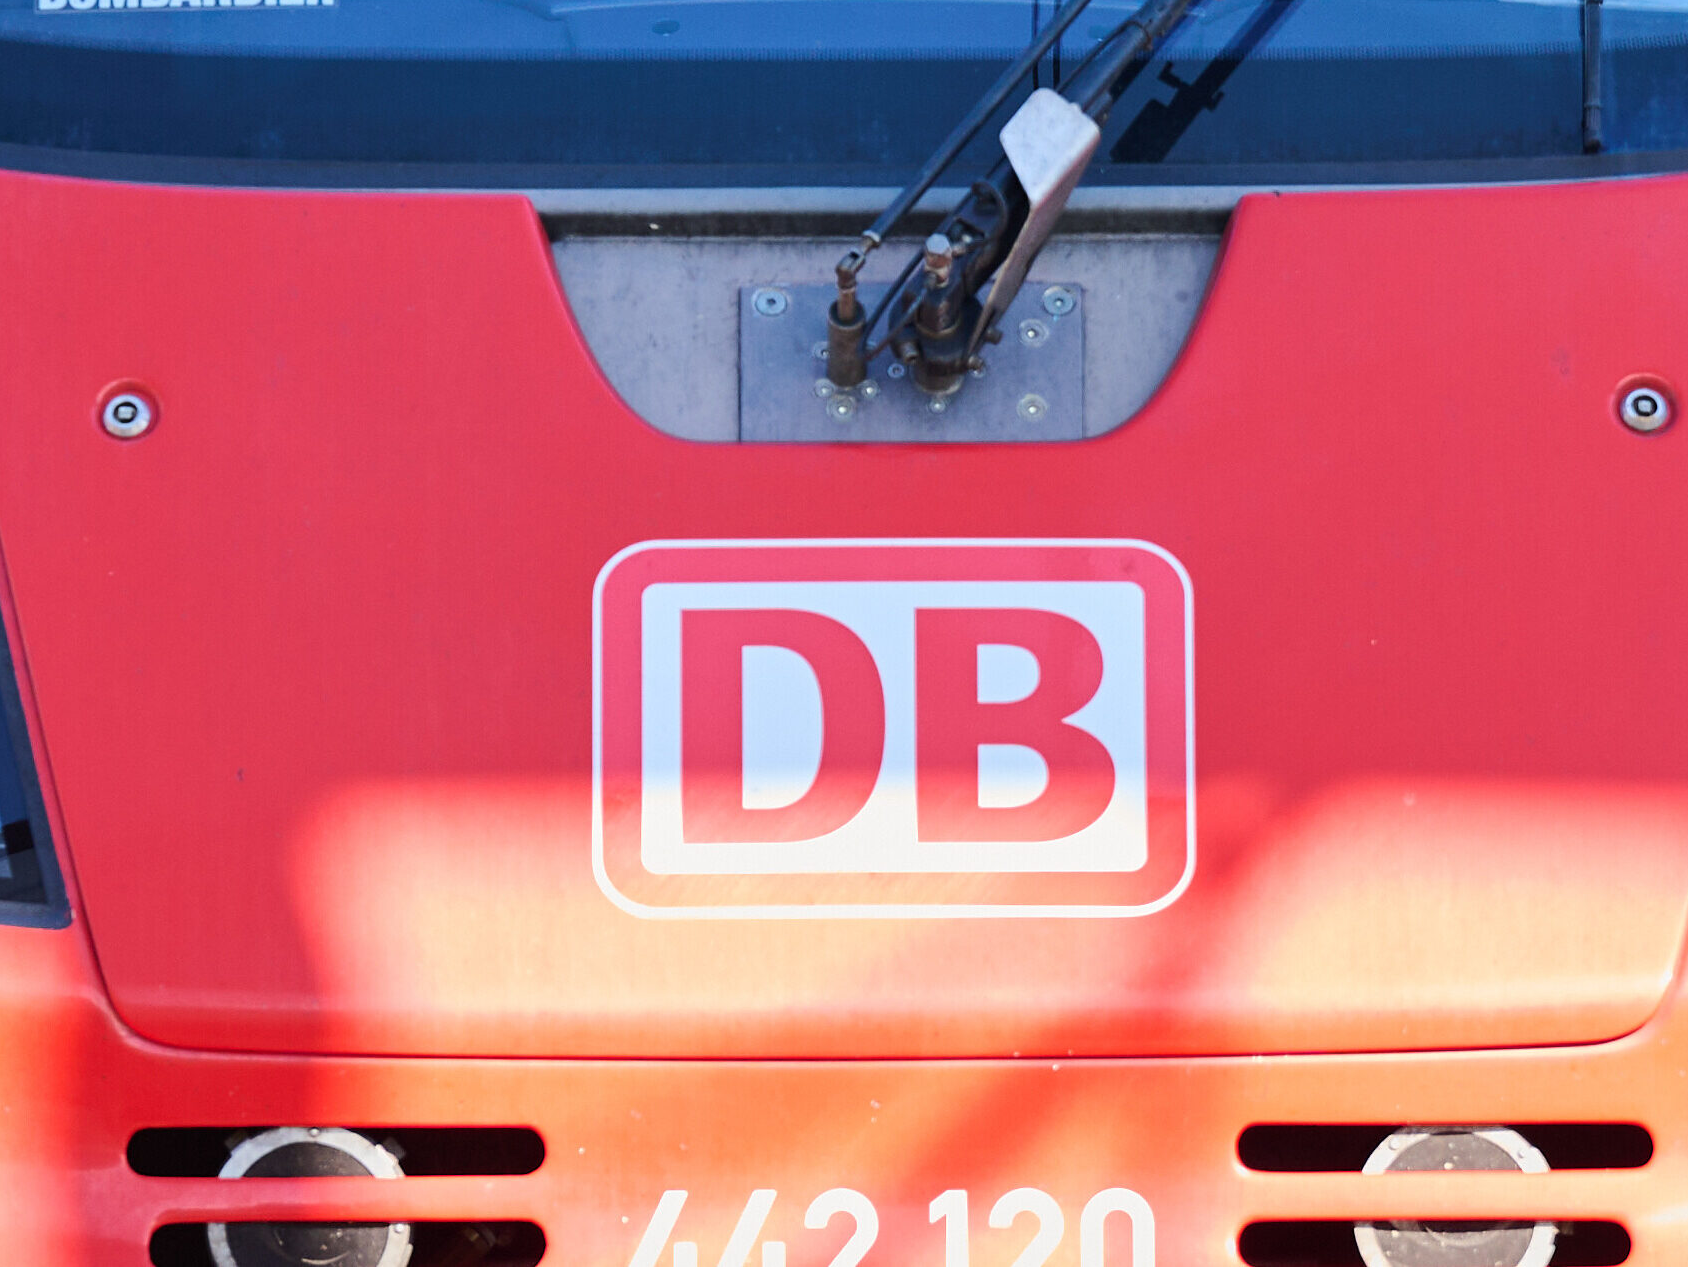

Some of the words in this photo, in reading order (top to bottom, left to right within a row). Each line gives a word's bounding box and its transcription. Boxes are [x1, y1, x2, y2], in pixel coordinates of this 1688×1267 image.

[680, 607, 1116, 845] DB
[628, 1187, 879, 1267] 442
[928, 1187, 1156, 1267] 120
